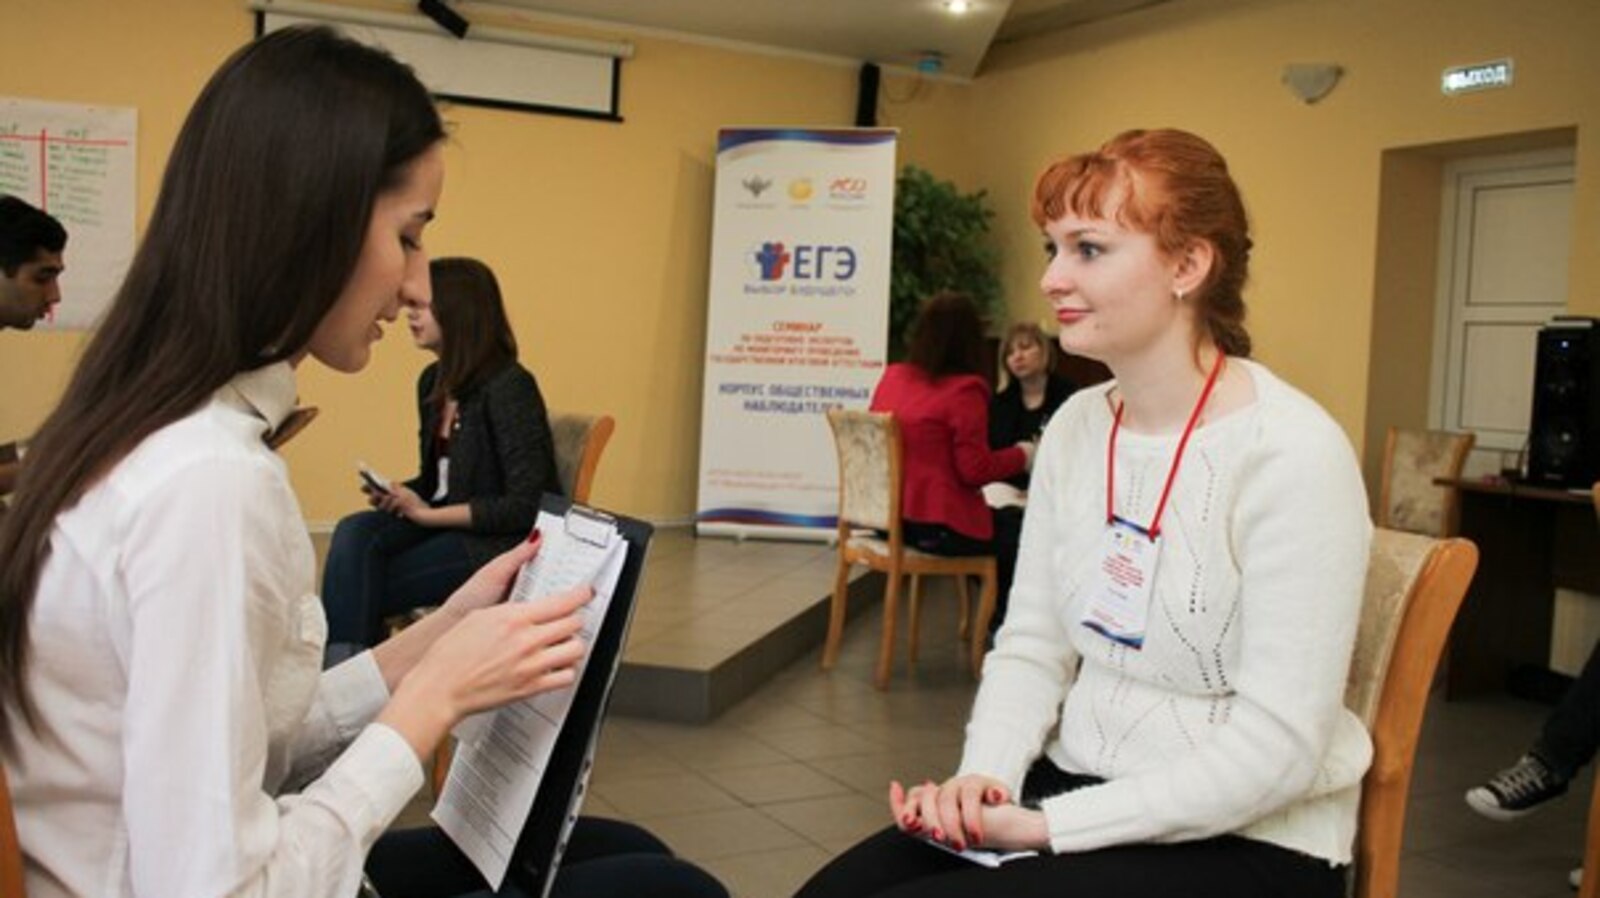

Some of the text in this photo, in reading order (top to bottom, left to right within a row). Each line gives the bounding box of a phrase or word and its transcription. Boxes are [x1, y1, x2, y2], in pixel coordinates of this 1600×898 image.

[794, 246, 857, 280] ЕГЭ
[772, 322, 823, 331] СЕМИНАР
[719, 383, 870, 398] КОРПУС ОБЩЕСТВЕННЫХ
